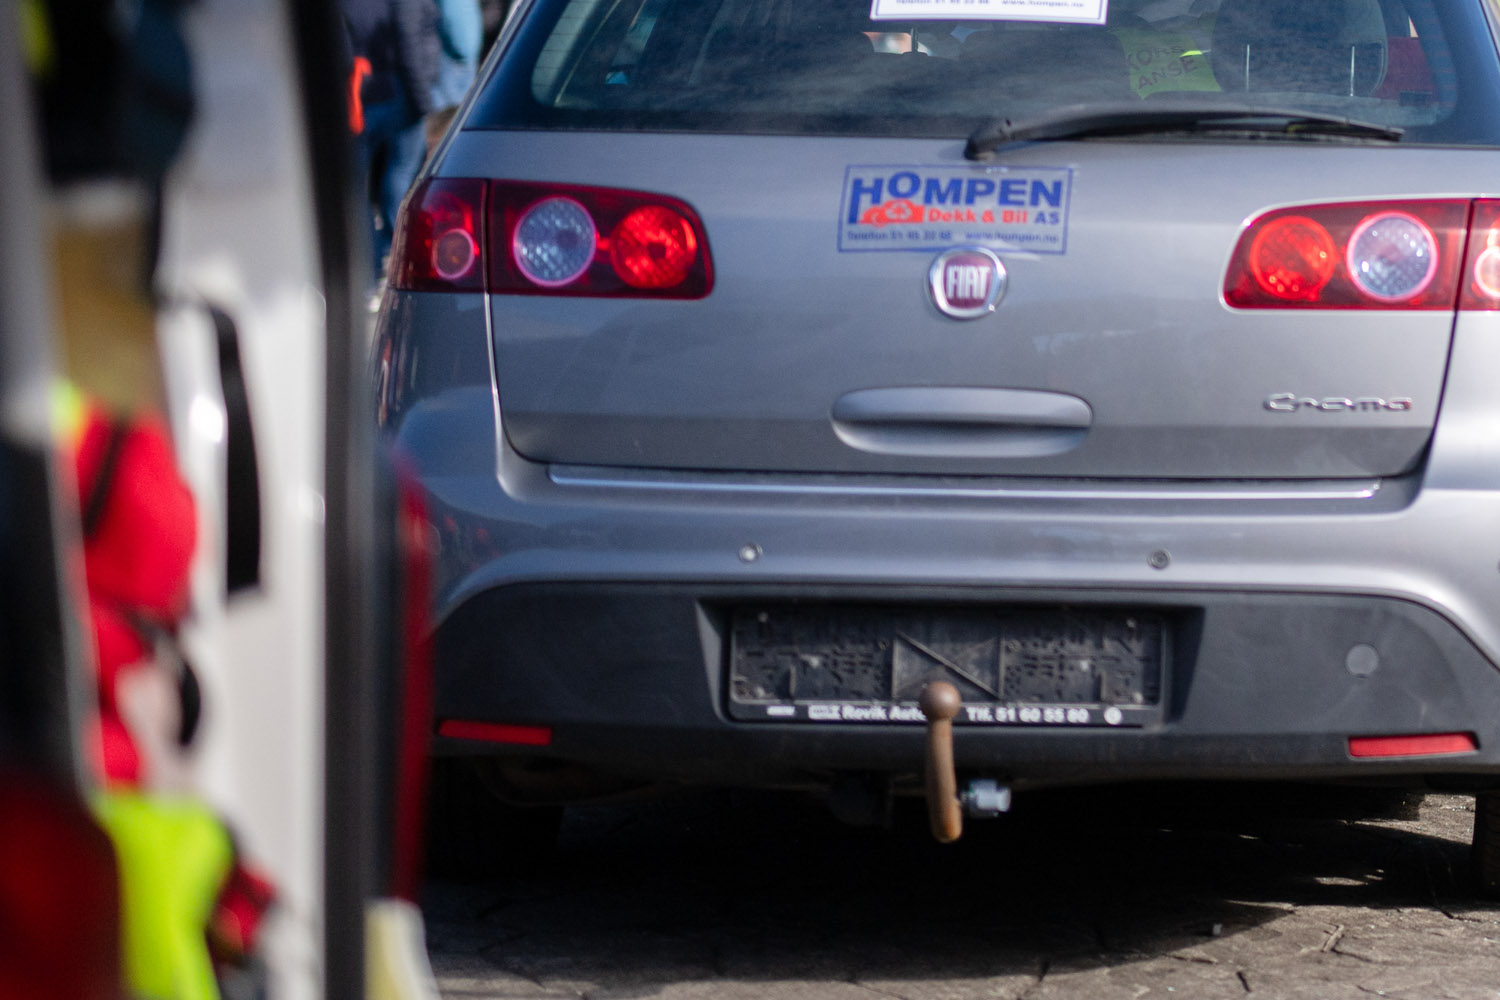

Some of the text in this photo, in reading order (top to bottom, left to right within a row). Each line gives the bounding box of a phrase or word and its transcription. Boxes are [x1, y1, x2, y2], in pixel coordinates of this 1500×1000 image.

[848, 171, 1063, 224] HOMPEN
[928, 207, 1060, 225] Dekk & Bil AS
[947, 265, 990, 299] FIAT
[1265, 393, 1412, 412] Croma
